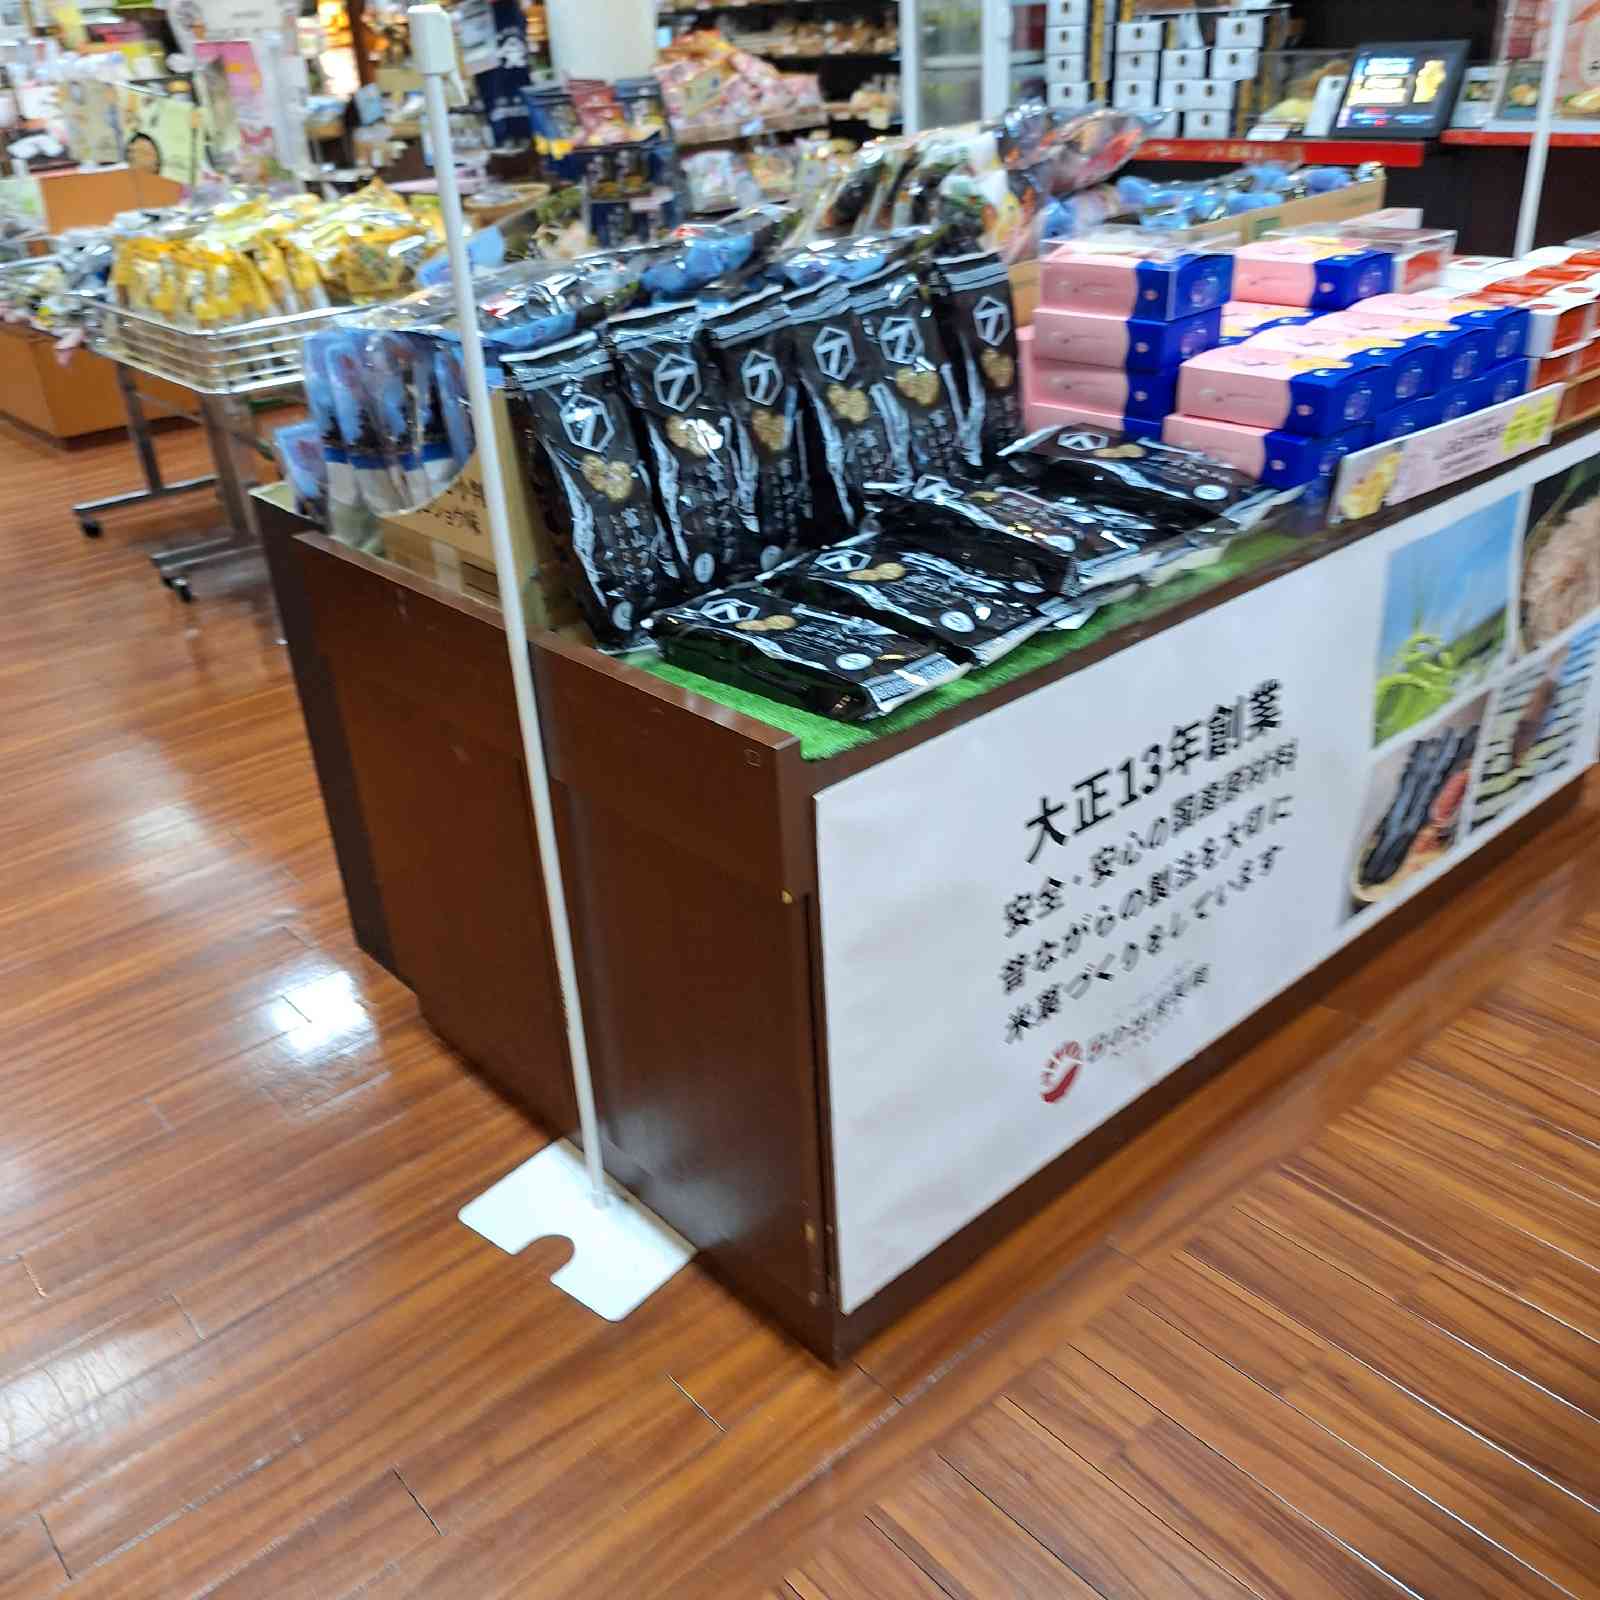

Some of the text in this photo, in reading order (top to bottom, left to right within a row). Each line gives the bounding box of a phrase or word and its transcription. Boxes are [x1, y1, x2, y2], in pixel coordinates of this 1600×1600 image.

[1024, 678, 1282, 864] 大正13年創業
